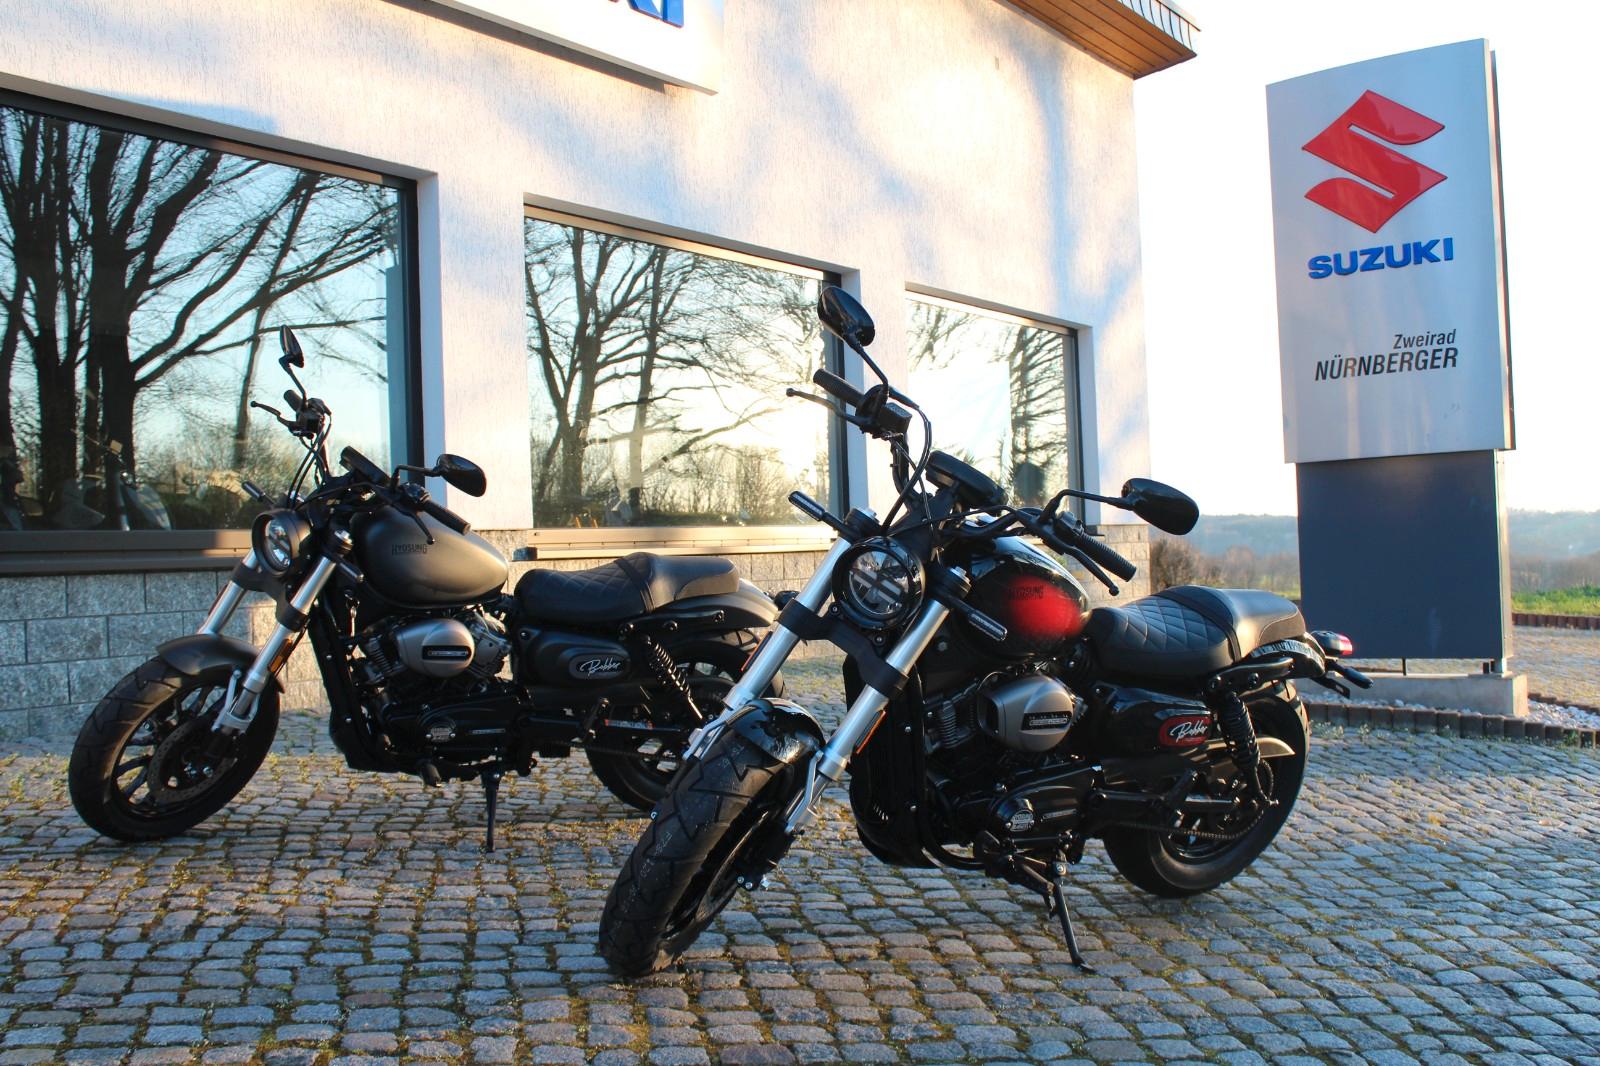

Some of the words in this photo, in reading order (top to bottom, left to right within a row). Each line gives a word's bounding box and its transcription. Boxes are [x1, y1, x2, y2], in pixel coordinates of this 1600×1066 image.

[1308, 237, 1454, 280] SUZUKI
[1393, 328, 1457, 350] Zweirad
[1315, 347, 1459, 382] NÜRNBERGER
